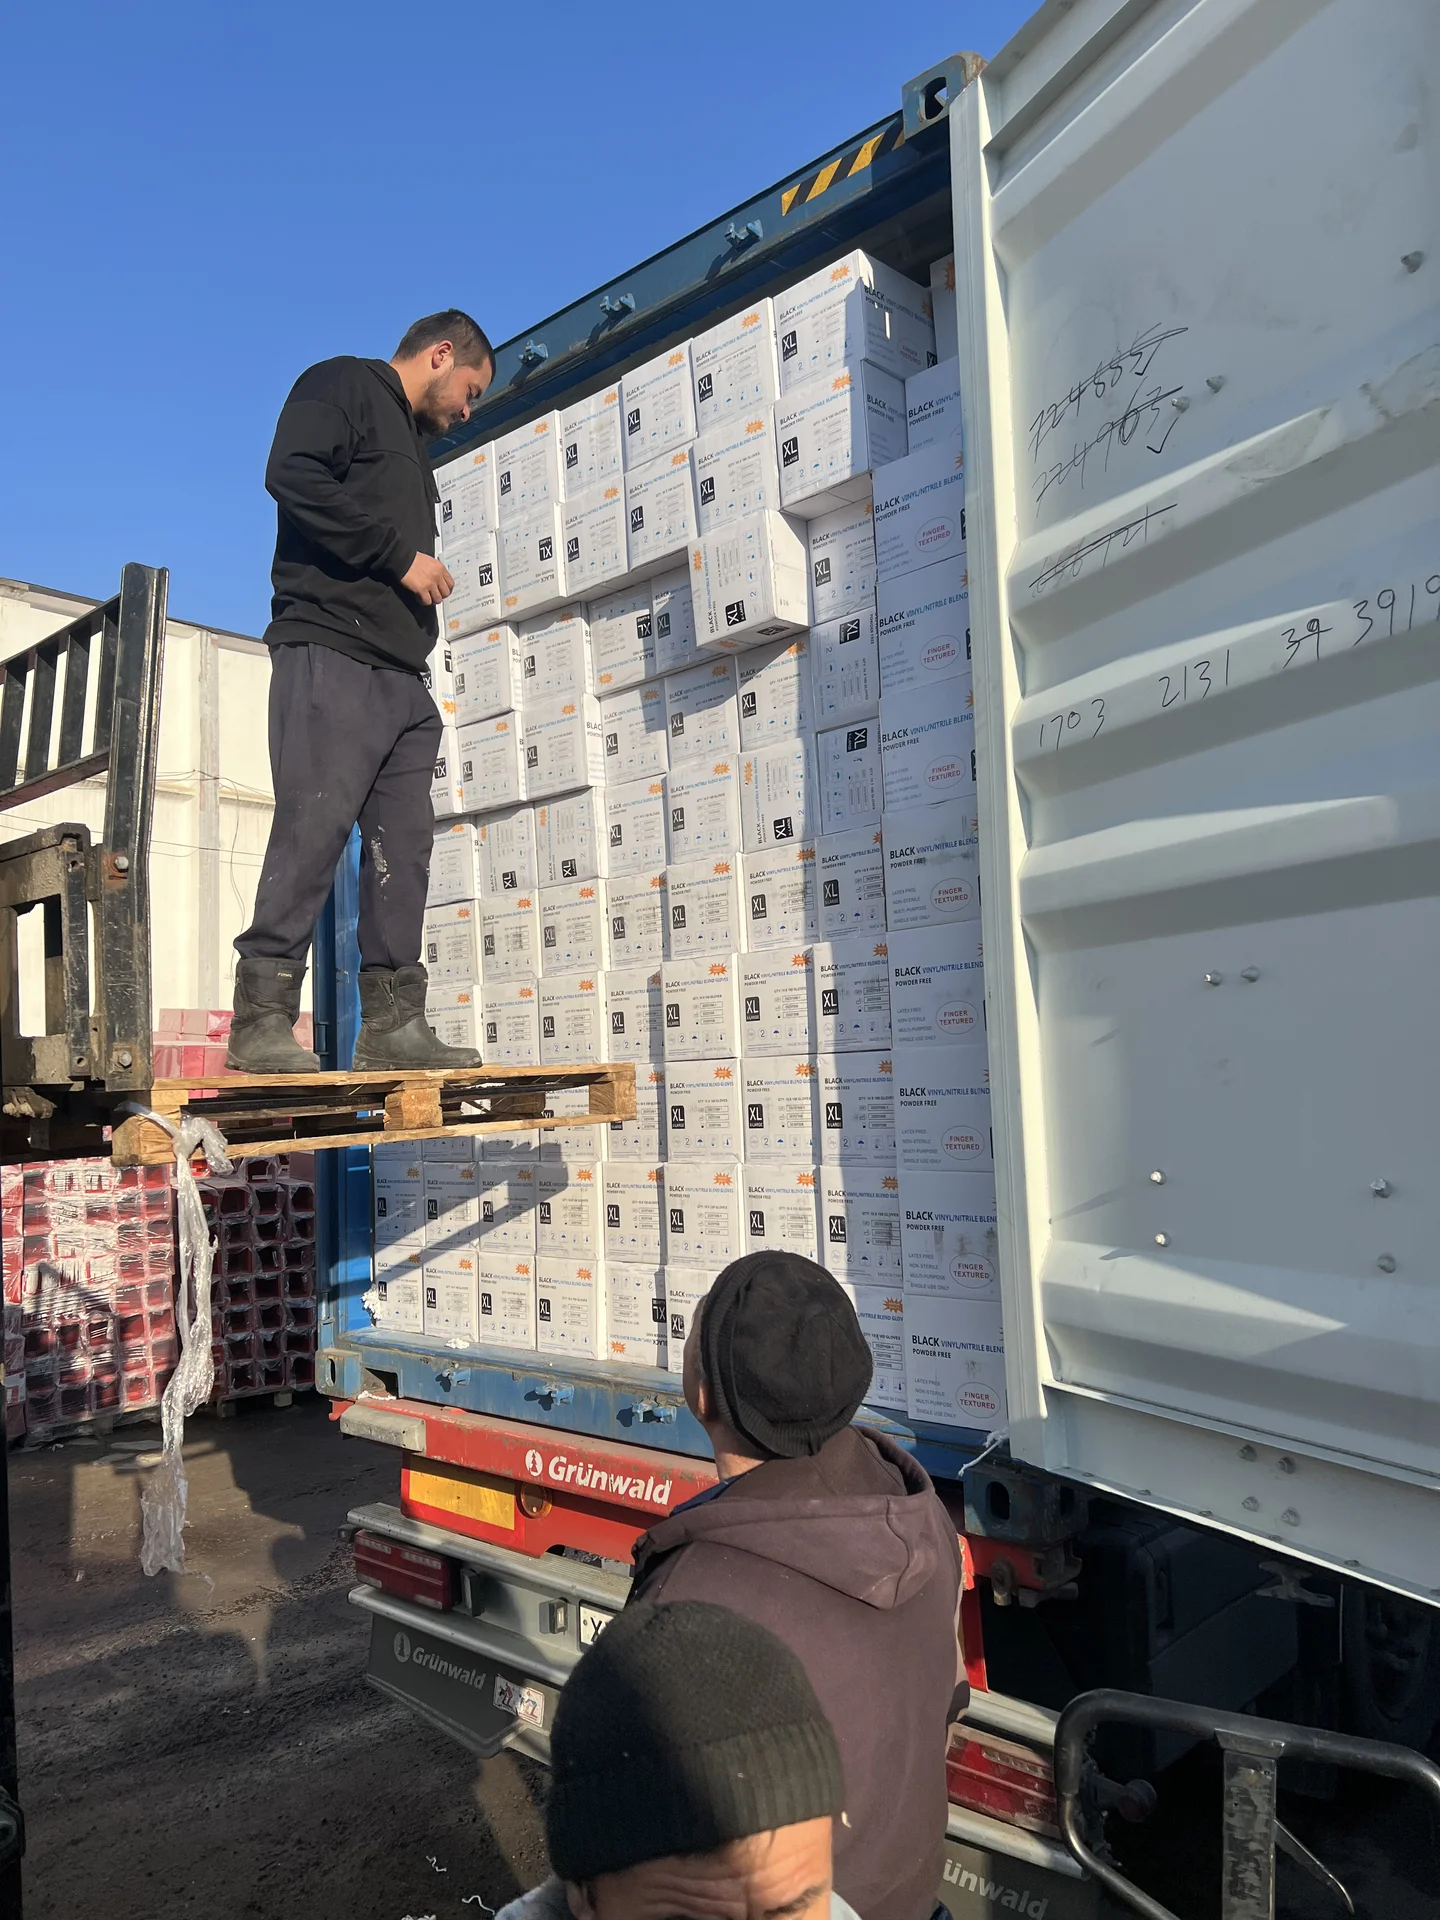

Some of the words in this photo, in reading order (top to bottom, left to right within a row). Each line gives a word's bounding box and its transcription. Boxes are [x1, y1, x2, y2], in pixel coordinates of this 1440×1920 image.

[864, 286, 885, 301] BLACK
[783, 335, 796, 352] XL
[699, 377, 712, 393] XL
[866, 393, 886, 411] BLACK
[908, 399, 934, 419] BLACK
[935, 390, 960, 406] VINYL/NI
[628, 413, 640, 427] XL
[780, 412, 797, 425] BLACK
[909, 411, 931, 427] POWDER
[932, 407, 945, 420] FREE
[566, 448, 577, 459] XL
[784, 441, 798, 457] XL
[698, 453, 714, 464] BLACK
[501, 476, 511, 487] XL
[701, 483, 714, 497] XL
[875, 496, 900, 514] BLACK
[901, 480, 942, 502] VINYL/NITRILE
[943, 473, 964, 485] BLEND
[632, 511, 643, 524] XL
[876, 508, 897, 523] POWDER
[898, 503, 911, 513] FREE
[922, 524, 946, 537] FINGER
[812, 533, 830, 545] BLACK
[918, 531, 951, 547] TEXTURED
[540, 546, 552, 558] XL
[568, 542, 578, 553] XL
[815, 562, 830, 577] XL
[728, 604, 738, 625] XL
[879, 611, 905, 628] BLACK
[906, 598, 947, 618] VINYL/NITRILE
[948, 592, 969, 604] BLEND
[638, 623, 651, 636] XL
[846, 620, 859, 641] XL
[880, 623, 902, 637] POWDER
[903, 619, 915, 629] FREE
[927, 643, 950, 655] FINGER
[923, 649, 956, 664] TEXTURED
[524, 660, 535, 671] XL
[742, 695, 756, 709] XL
[1040, 699, 1105, 750] 1703
[1159, 650, 1230, 707] 2131
[882, 729, 908, 743] BLACK
[909, 718, 952, 736] VINYL/NITRILE
[953, 712, 974, 724] BLEND
[854, 729, 866, 749] XL
[883, 741, 906, 752] POWDER
[907, 737, 919, 746] FREE
[527, 750, 537, 761] XL
[435, 765, 446, 777] XL
[931, 763, 955, 774] FINGER
[928, 770, 961, 783] TEXTURED
[671, 785, 685, 793] BLACK
[673, 811, 684, 823] XL
[611, 828, 622, 839] XL
[776, 819, 785, 839] XL
[889, 846, 915, 860] BLACK
[916, 839, 958, 854] VINYL/NITRILE
[958, 837, 978, 846] BLEND
[821, 855, 839, 864] BLACK
[890, 859, 913, 869] POWDER
[913, 857, 926, 865] FREE
[563, 861, 572, 878] XL
[750, 871, 766, 879] BLACK
[671, 882, 685, 891] BLACK
[824, 885, 838, 898] XL
[938, 887, 963, 896] FINGER
[752, 899, 765, 911] XL
[934, 893, 969, 905] TEXTURED
[673, 909, 685, 921] XL
[545, 929, 555, 940] XL
[820, 964, 838, 972] BLACK
[895, 966, 921, 978] BLACK
[922, 963, 963, 974] VINYL/NITRILE
[964, 961, 984, 970] BLEND
[744, 972, 760, 981] BLACK
[895, 979, 918, 987] POWDER
[919, 977, 932, 985] FREE
[823, 993, 837, 1007] XL
[667, 1008, 679, 1020] XL
[746, 1002, 759, 1014] XL
[943, 1010, 968, 1018] FINGER
[544, 1020, 554, 1031] XL
[613, 1016, 623, 1027] XL
[939, 1017, 974, 1026] TEXTURED
[487, 1026, 496, 1036] XL
[899, 1087, 926, 1097] BLACK
[927, 1088, 969, 1096] VINYL/NITRILE
[672, 1110, 684, 1122] XL
[749, 1107, 762, 1120] XL
[827, 1105, 841, 1120] XL
[949, 1135, 974, 1143] FINGER
[945, 1143, 980, 1151] TEXTURED
[669, 1185, 685, 1193] BLACK
[484, 1205, 493, 1215] XL
[540, 1206, 550, 1218] XL
[608, 1209, 619, 1221] XL
[671, 1212, 684, 1226] XL
[751, 1214, 763, 1228] XL
[906, 1210, 933, 1221] BLACK
[934, 1213, 978, 1223] VINYL/NITRILE
[830, 1219, 845, 1235] XL
[906, 1223, 930, 1232] POWDER
[931, 1224, 945, 1232] FREE
[957, 1263, 984, 1271] FINGER
[953, 1270, 990, 1280] TEXTURED
[378, 1285, 387, 1295] XL
[427, 1291, 436, 1302] XL
[482, 1297, 491, 1308] XL
[540, 1302, 550, 1315] XL
[653, 1307, 666, 1320] XL
[672, 1318, 684, 1331] XL
[912, 1334, 940, 1347] BLACK
[940, 1340, 985, 1352] VINYL/NITRILE
[912, 1348, 936, 1358] POWDER
[937, 1350, 952, 1359] FREE
[964, 1391, 990, 1400] FINGER
[959, 1398, 996, 1410] TEXTURED
[548, 1455, 673, 1506] Grünwald
[412, 1647, 487, 1690] Grünwald
[943, 1859, 1049, 1920] ünwald
